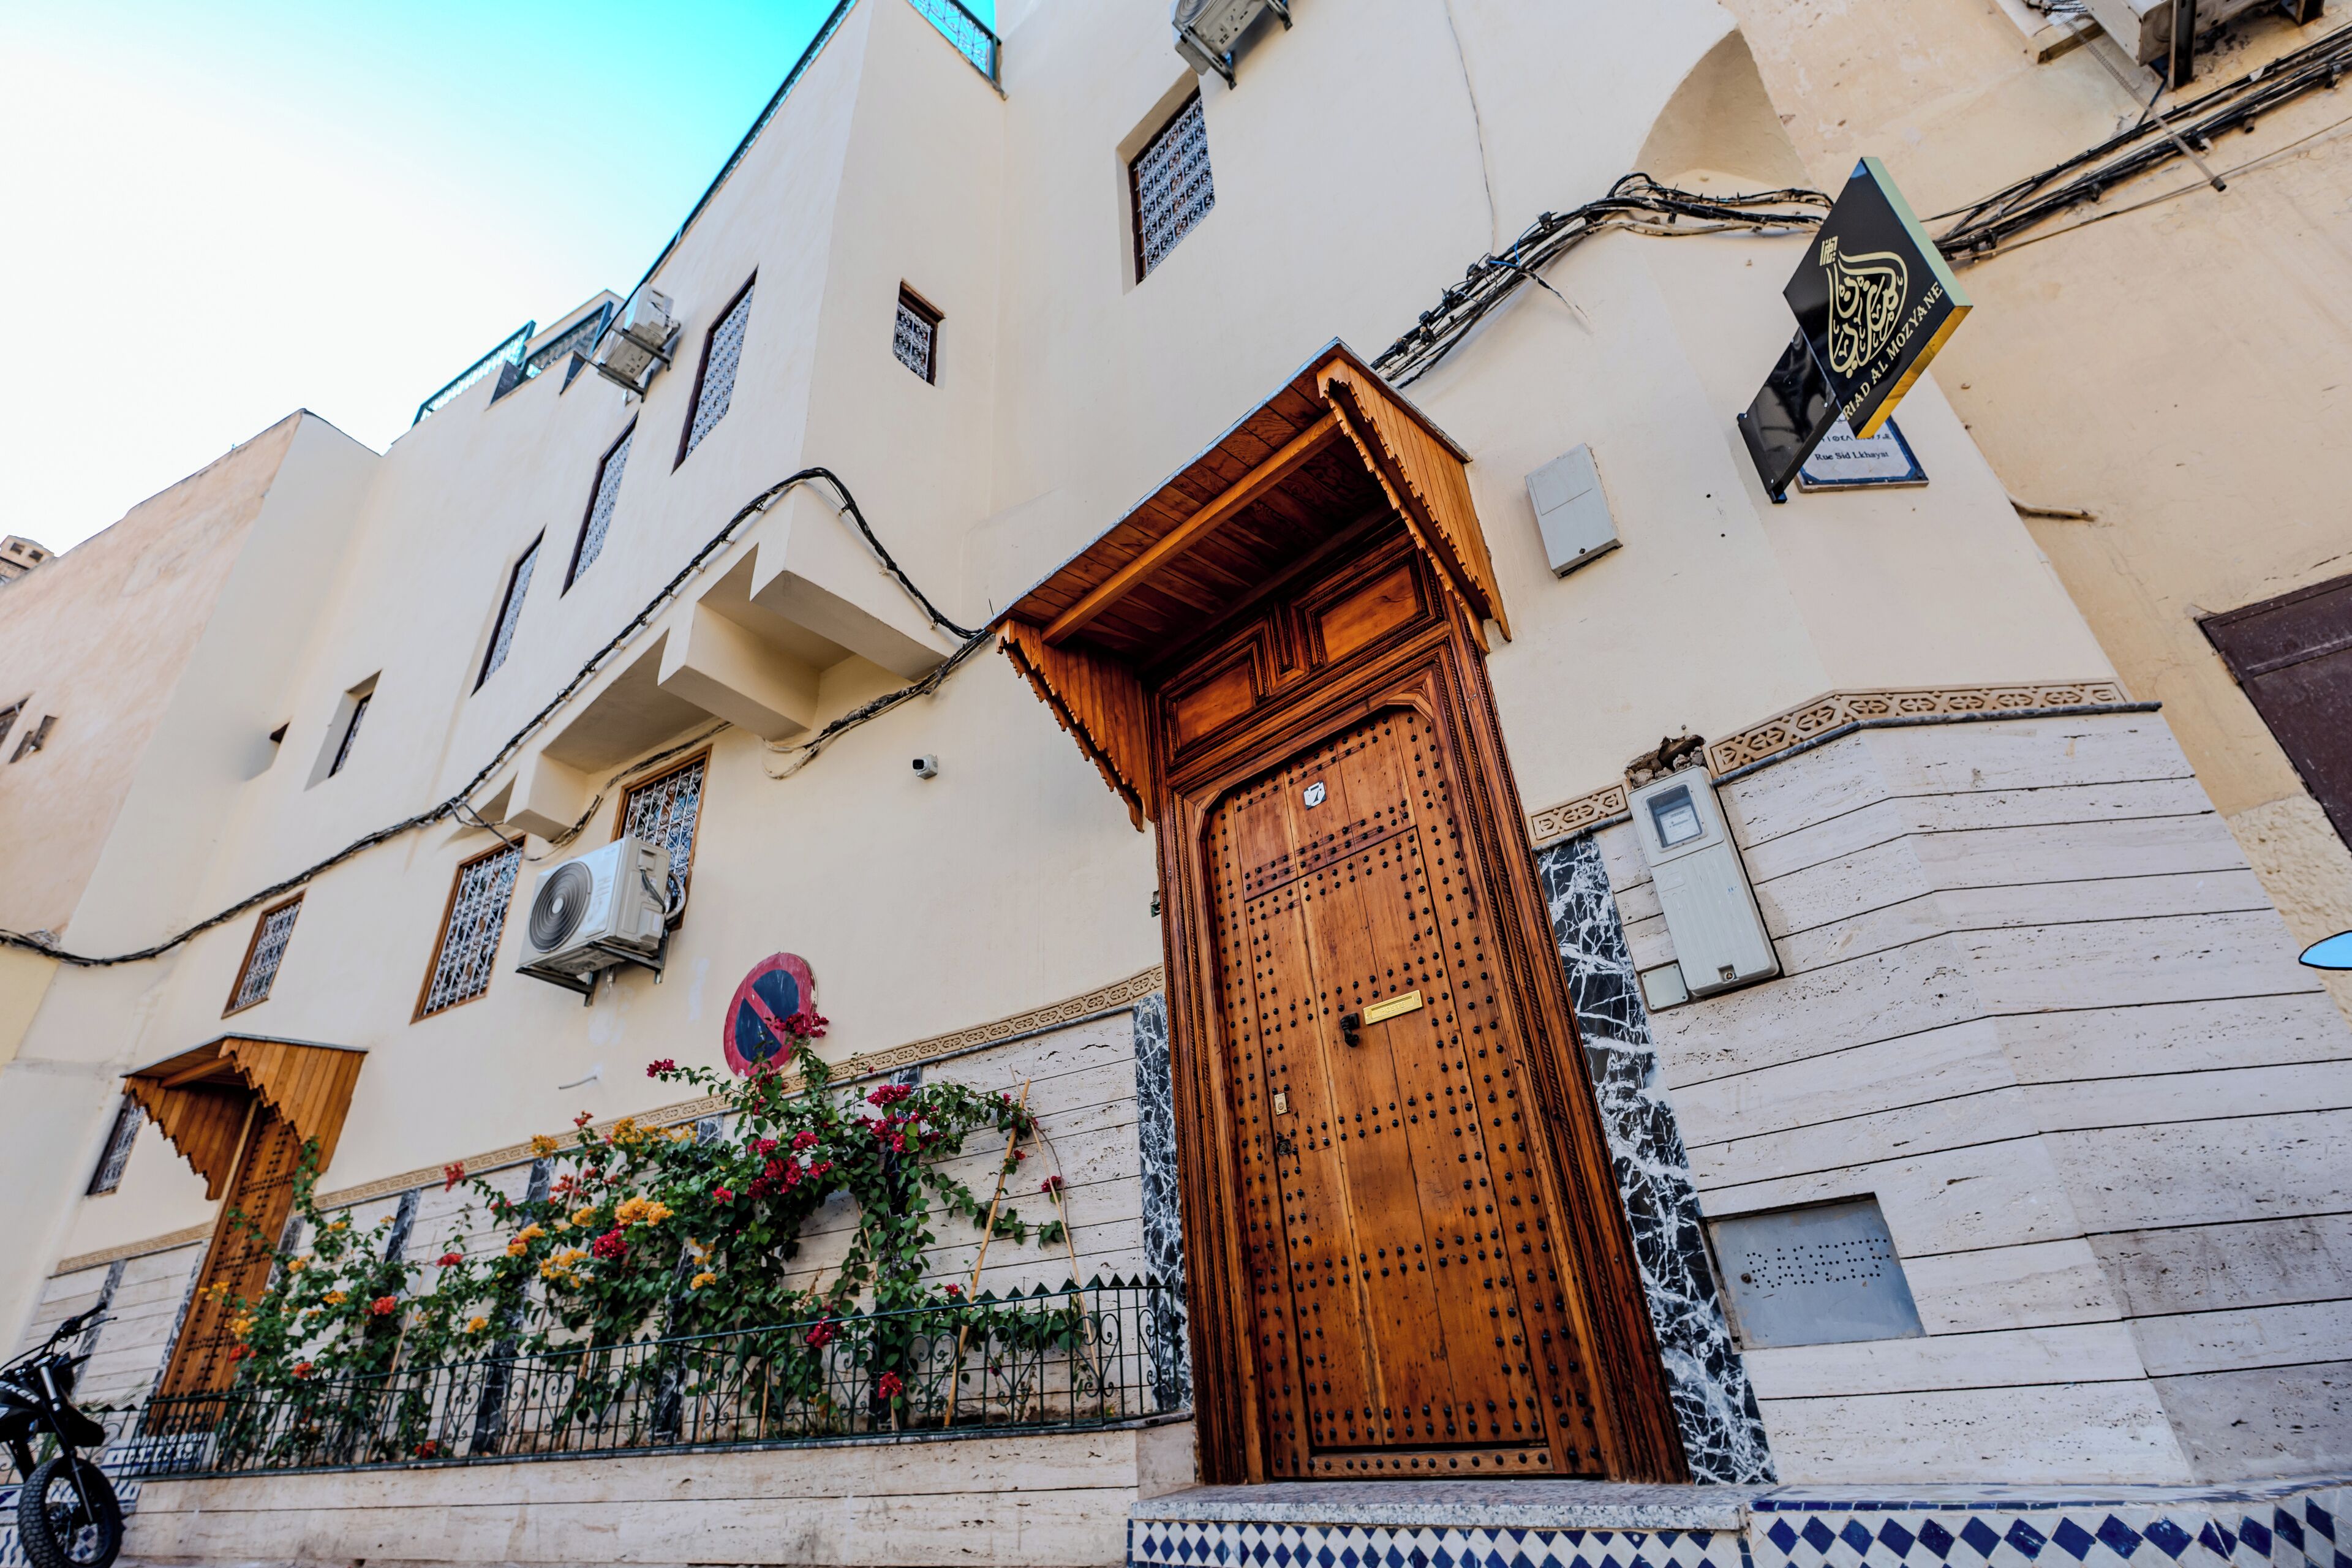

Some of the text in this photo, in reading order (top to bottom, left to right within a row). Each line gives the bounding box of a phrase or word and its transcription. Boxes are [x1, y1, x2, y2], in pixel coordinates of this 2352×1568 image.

[1842, 281, 1943, 420] RIAD AL MOZYANE
[1381, 1001, 1406, 1013] POSTE
